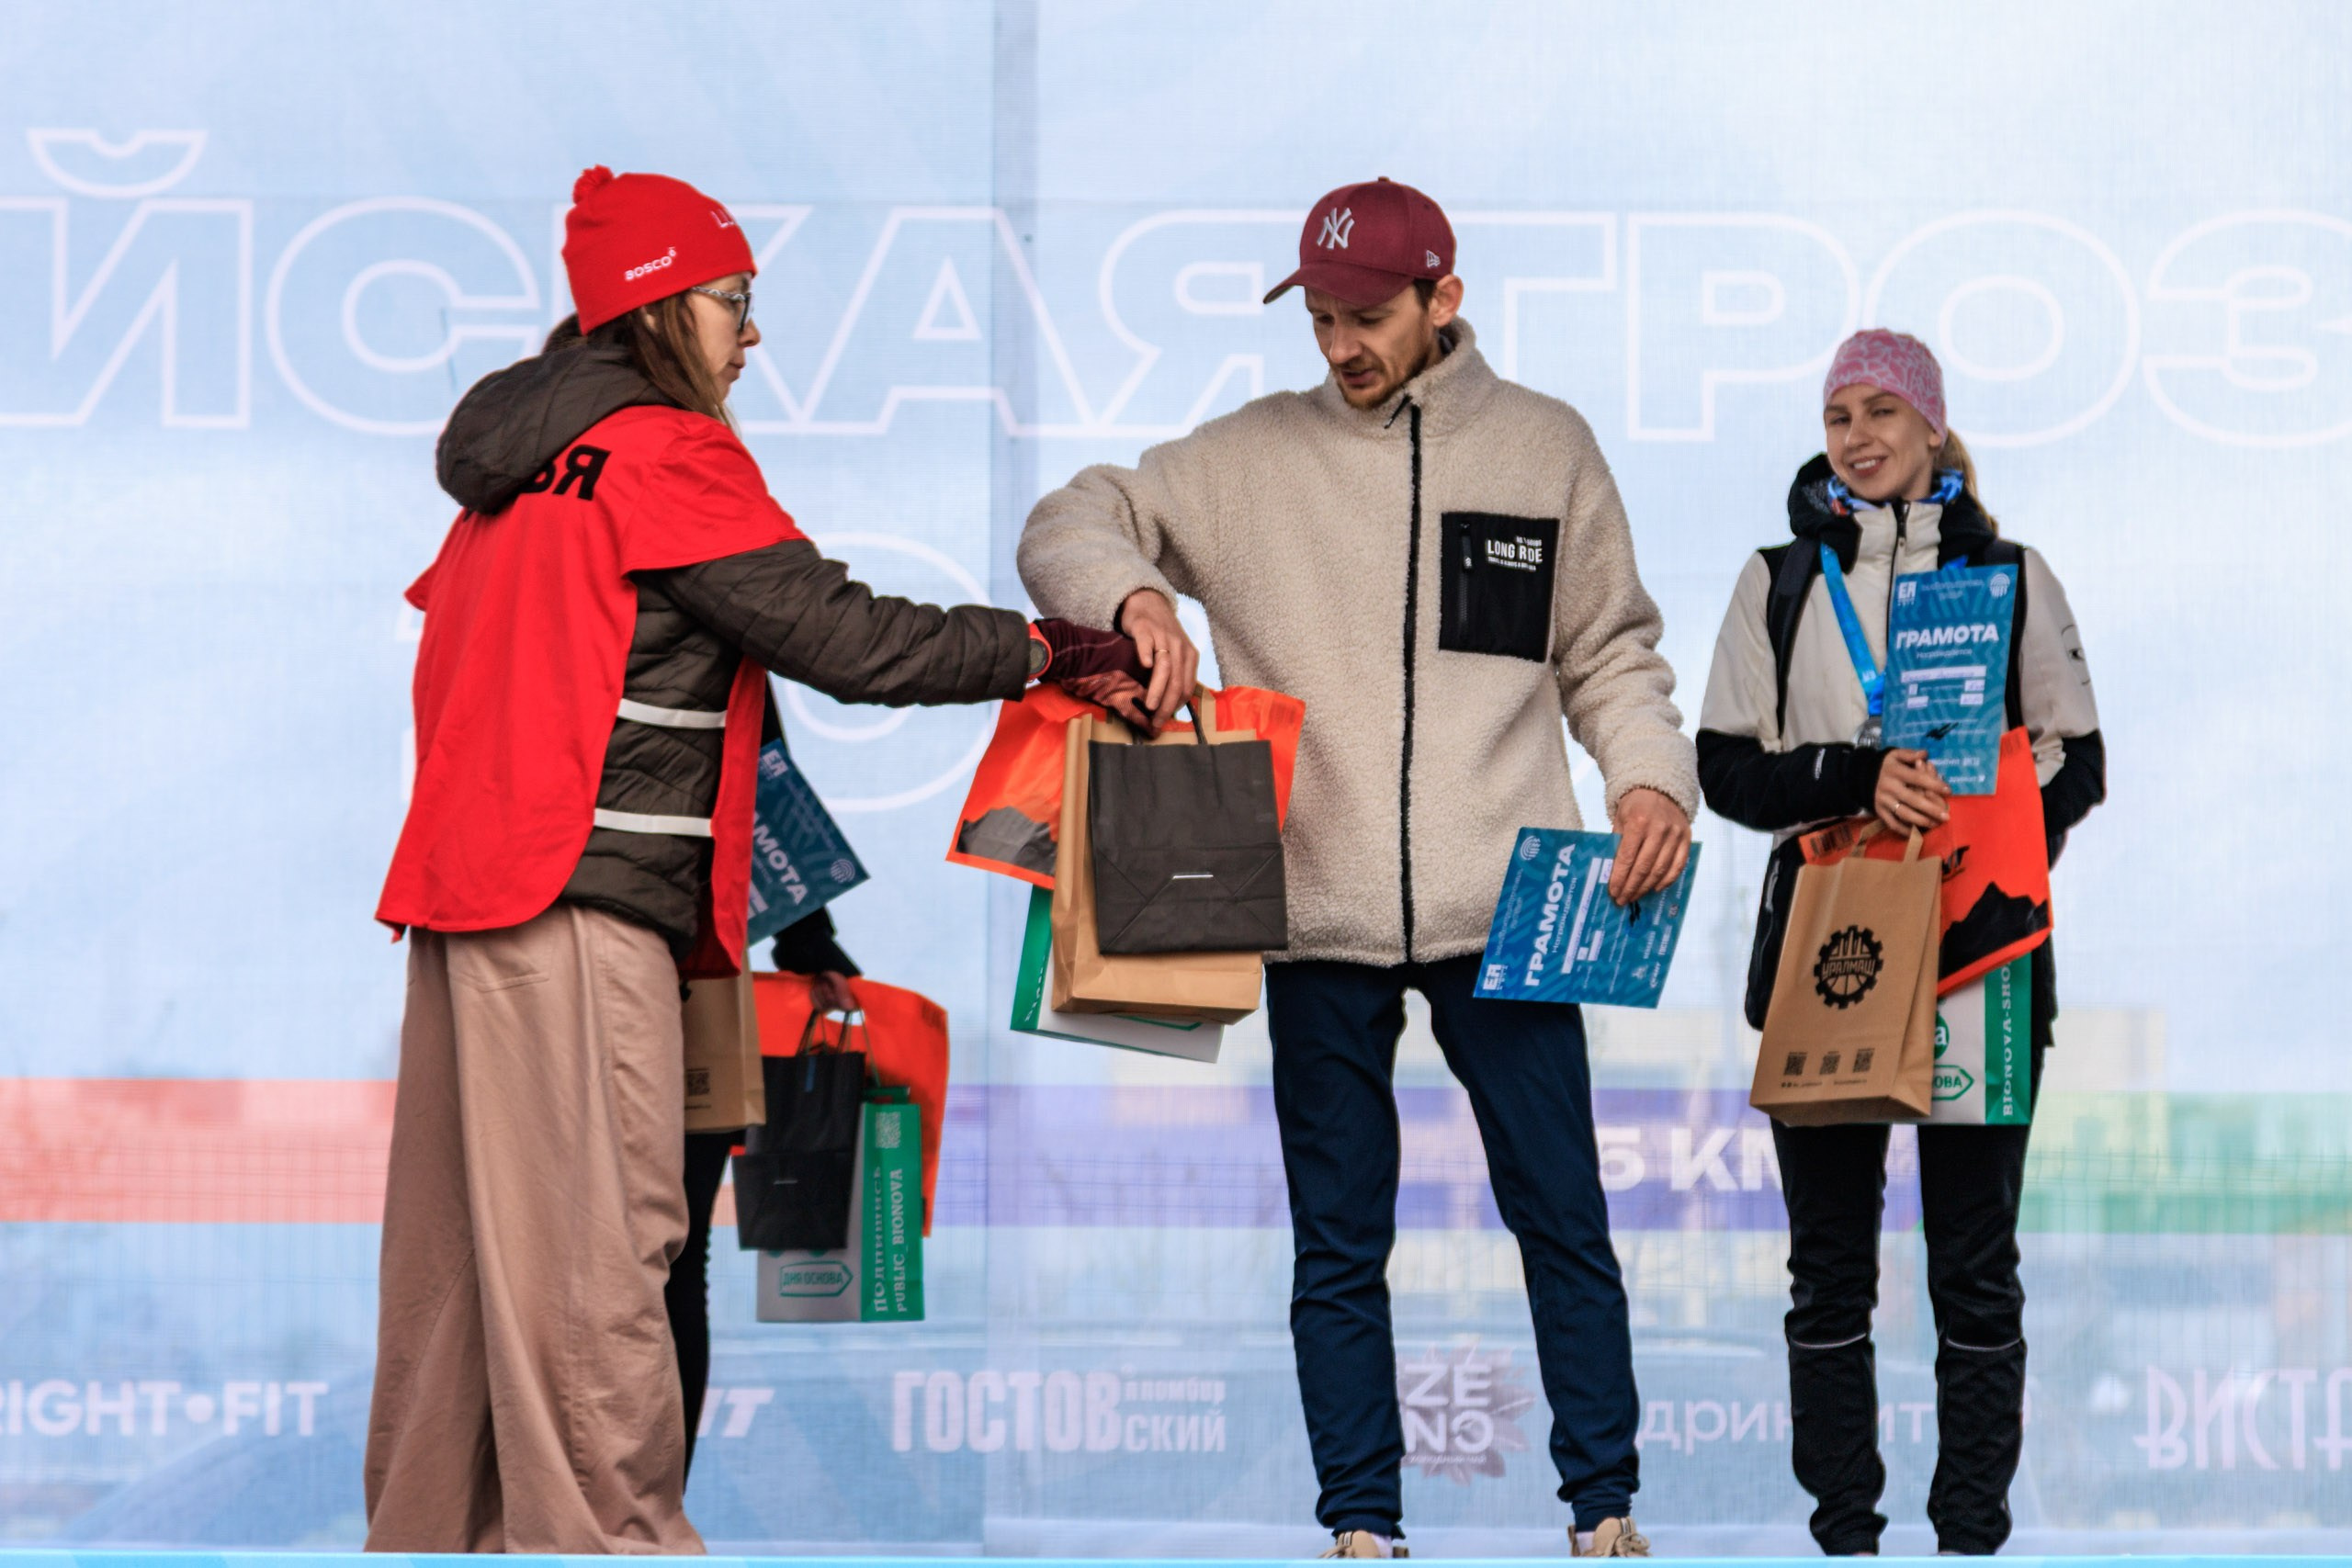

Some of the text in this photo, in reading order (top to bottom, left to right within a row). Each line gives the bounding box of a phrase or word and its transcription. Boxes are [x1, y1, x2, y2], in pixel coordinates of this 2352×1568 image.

[1317, 208, 1355, 250] NY
[624, 255, 673, 280] BOSCO
[1487, 539, 1517, 559] LONG
[1896, 624, 1999, 649] ГРАМОТА
[1524, 843, 1577, 987] ГРАМОТА
[2001, 962, 2013, 1116] BIONOVA-SHO
